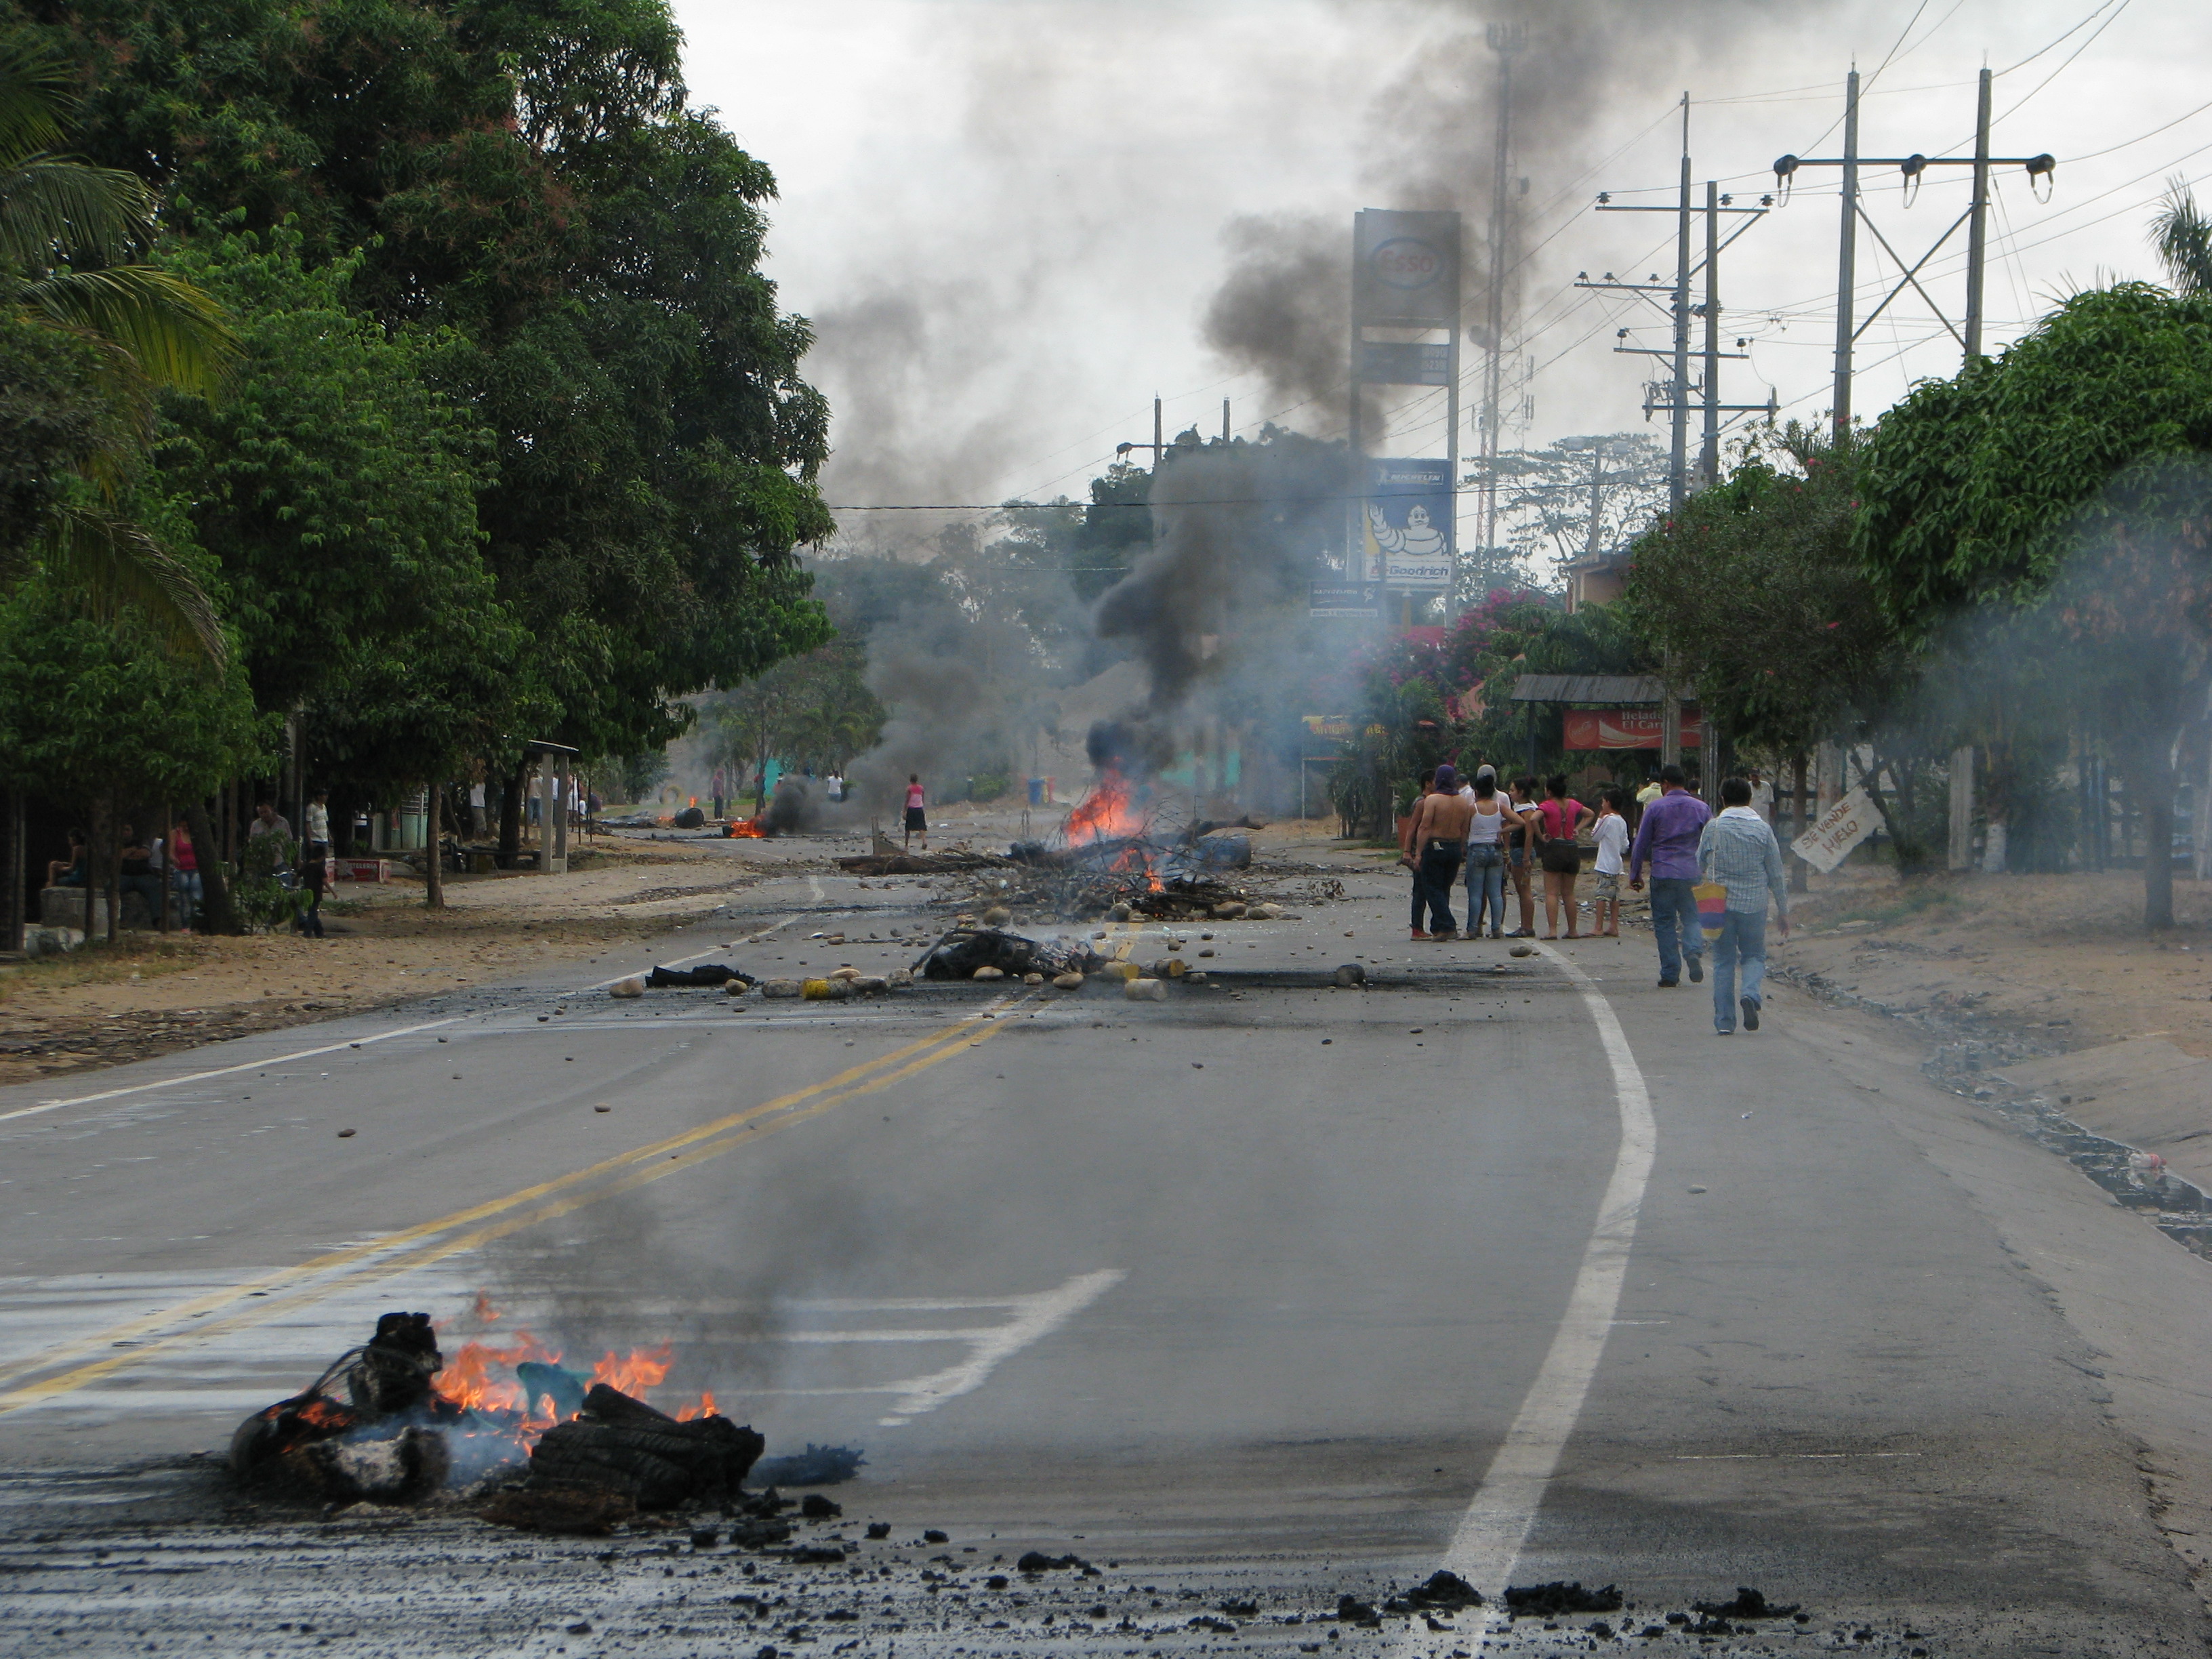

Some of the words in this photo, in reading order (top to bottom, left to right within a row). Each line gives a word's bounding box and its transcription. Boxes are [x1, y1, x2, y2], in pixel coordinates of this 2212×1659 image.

[1380, 248, 1433, 273] Esso
[1622, 720, 1634, 729] El
[1801, 831, 1819, 850] SE
[1822, 820, 1858, 855] HIELO
